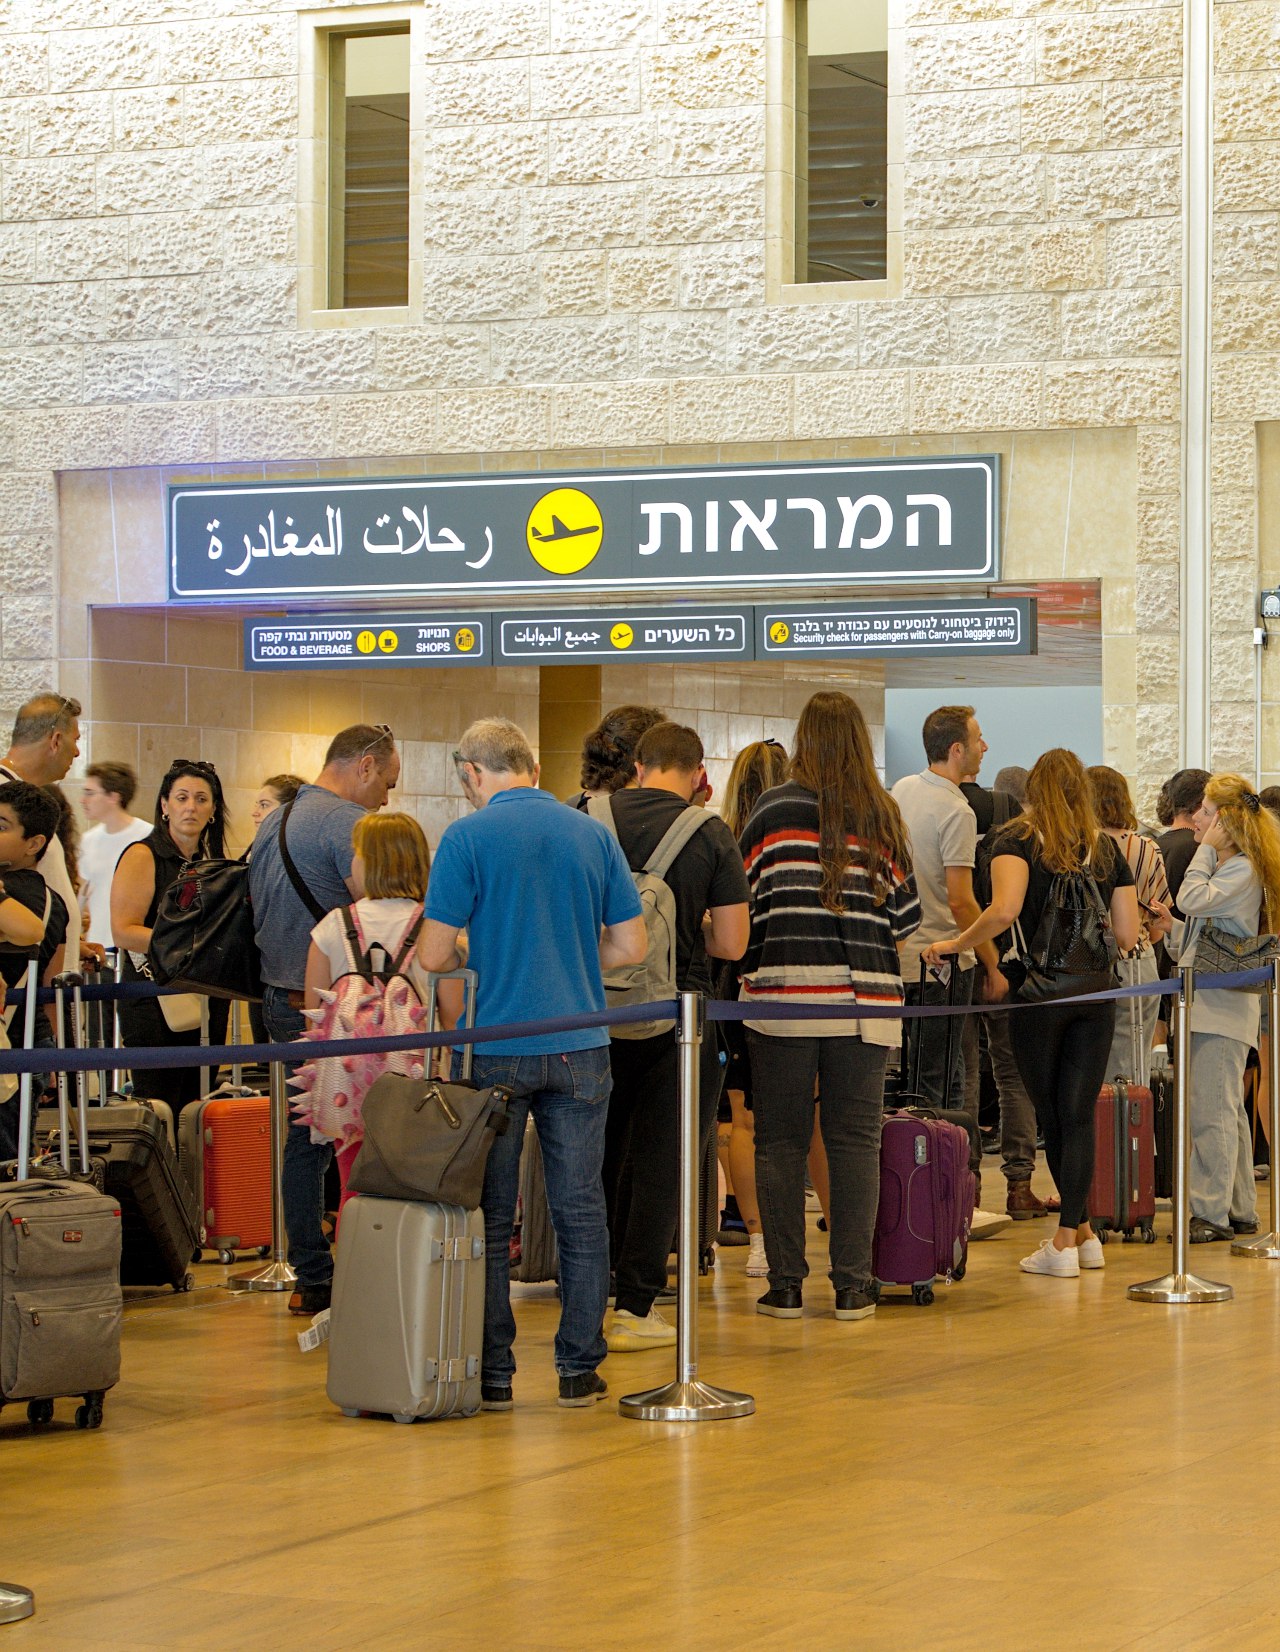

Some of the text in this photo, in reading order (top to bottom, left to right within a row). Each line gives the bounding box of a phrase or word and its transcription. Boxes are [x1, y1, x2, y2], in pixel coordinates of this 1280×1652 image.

[638, 493, 952, 556] המראות
[206, 504, 493, 576] رحلات المغادرة
[793, 616, 1015, 632] בידוק ביטחוני לנוסעים עם כבודת יד בלבד
[259, 630, 352, 644] מסעדות ובתי קפה
[417, 628, 450, 639] חנויות
[514, 626, 601, 649] جميع البوابات
[644, 624, 736, 644] כל השערים
[793, 628, 1015, 644] Security check for passengers with Carry-on baggage only
[261, 644, 353, 656] FOOD & BEVERAGE
[415, 642, 450, 653] SHOPS
